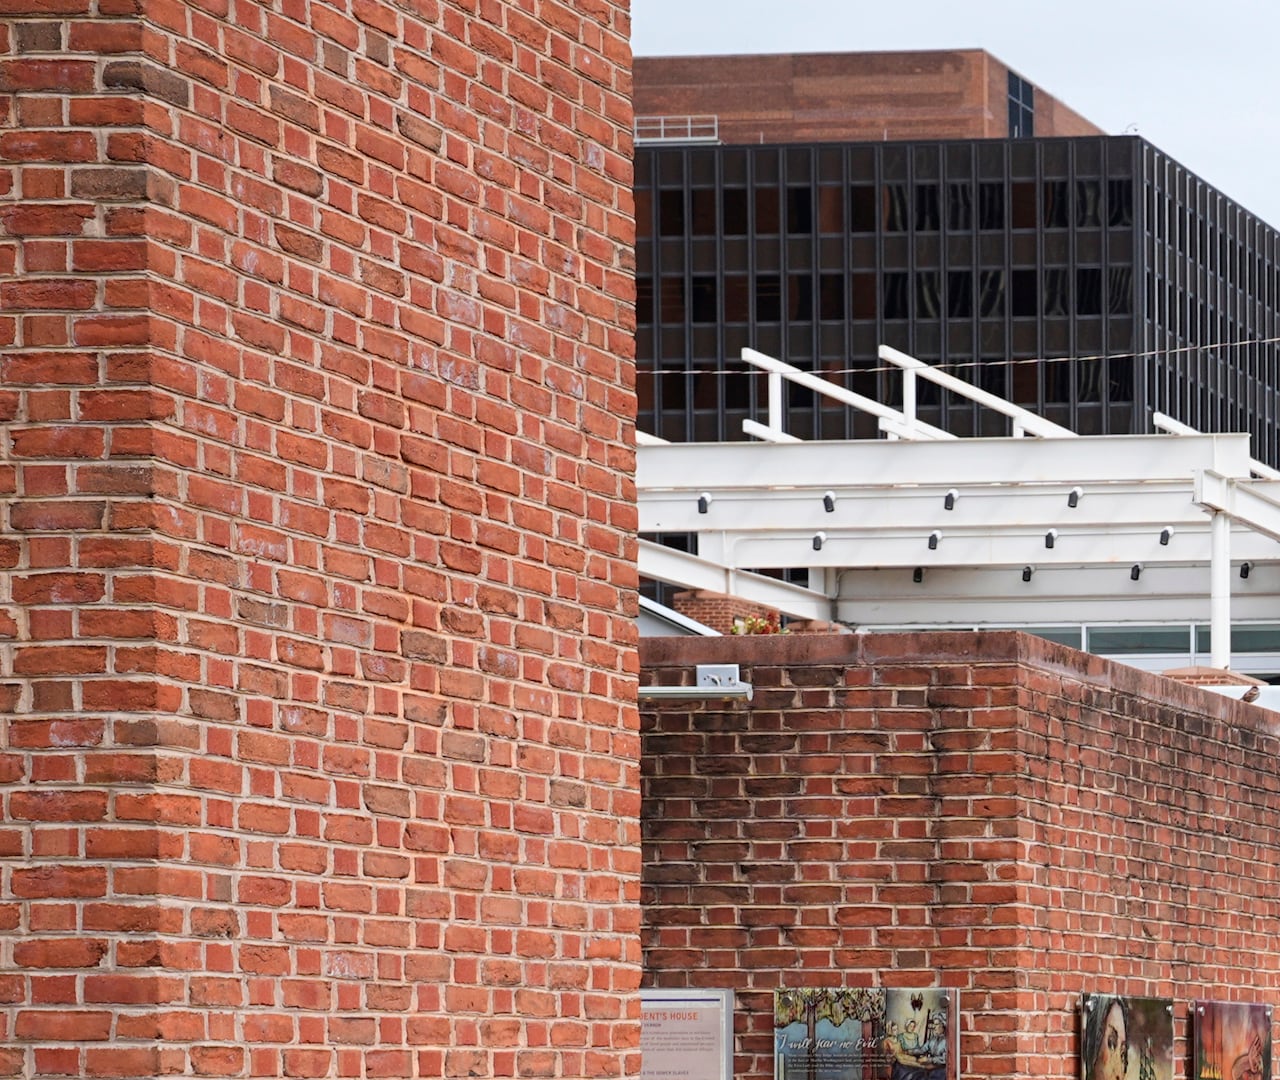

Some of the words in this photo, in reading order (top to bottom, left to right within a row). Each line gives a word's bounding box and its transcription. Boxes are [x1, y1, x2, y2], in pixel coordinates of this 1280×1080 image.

[670, 1012, 699, 1020] HOUSE
[788, 1038, 813, 1049] will
[811, 1038, 836, 1053] fear
[839, 1041, 853, 1049] no
